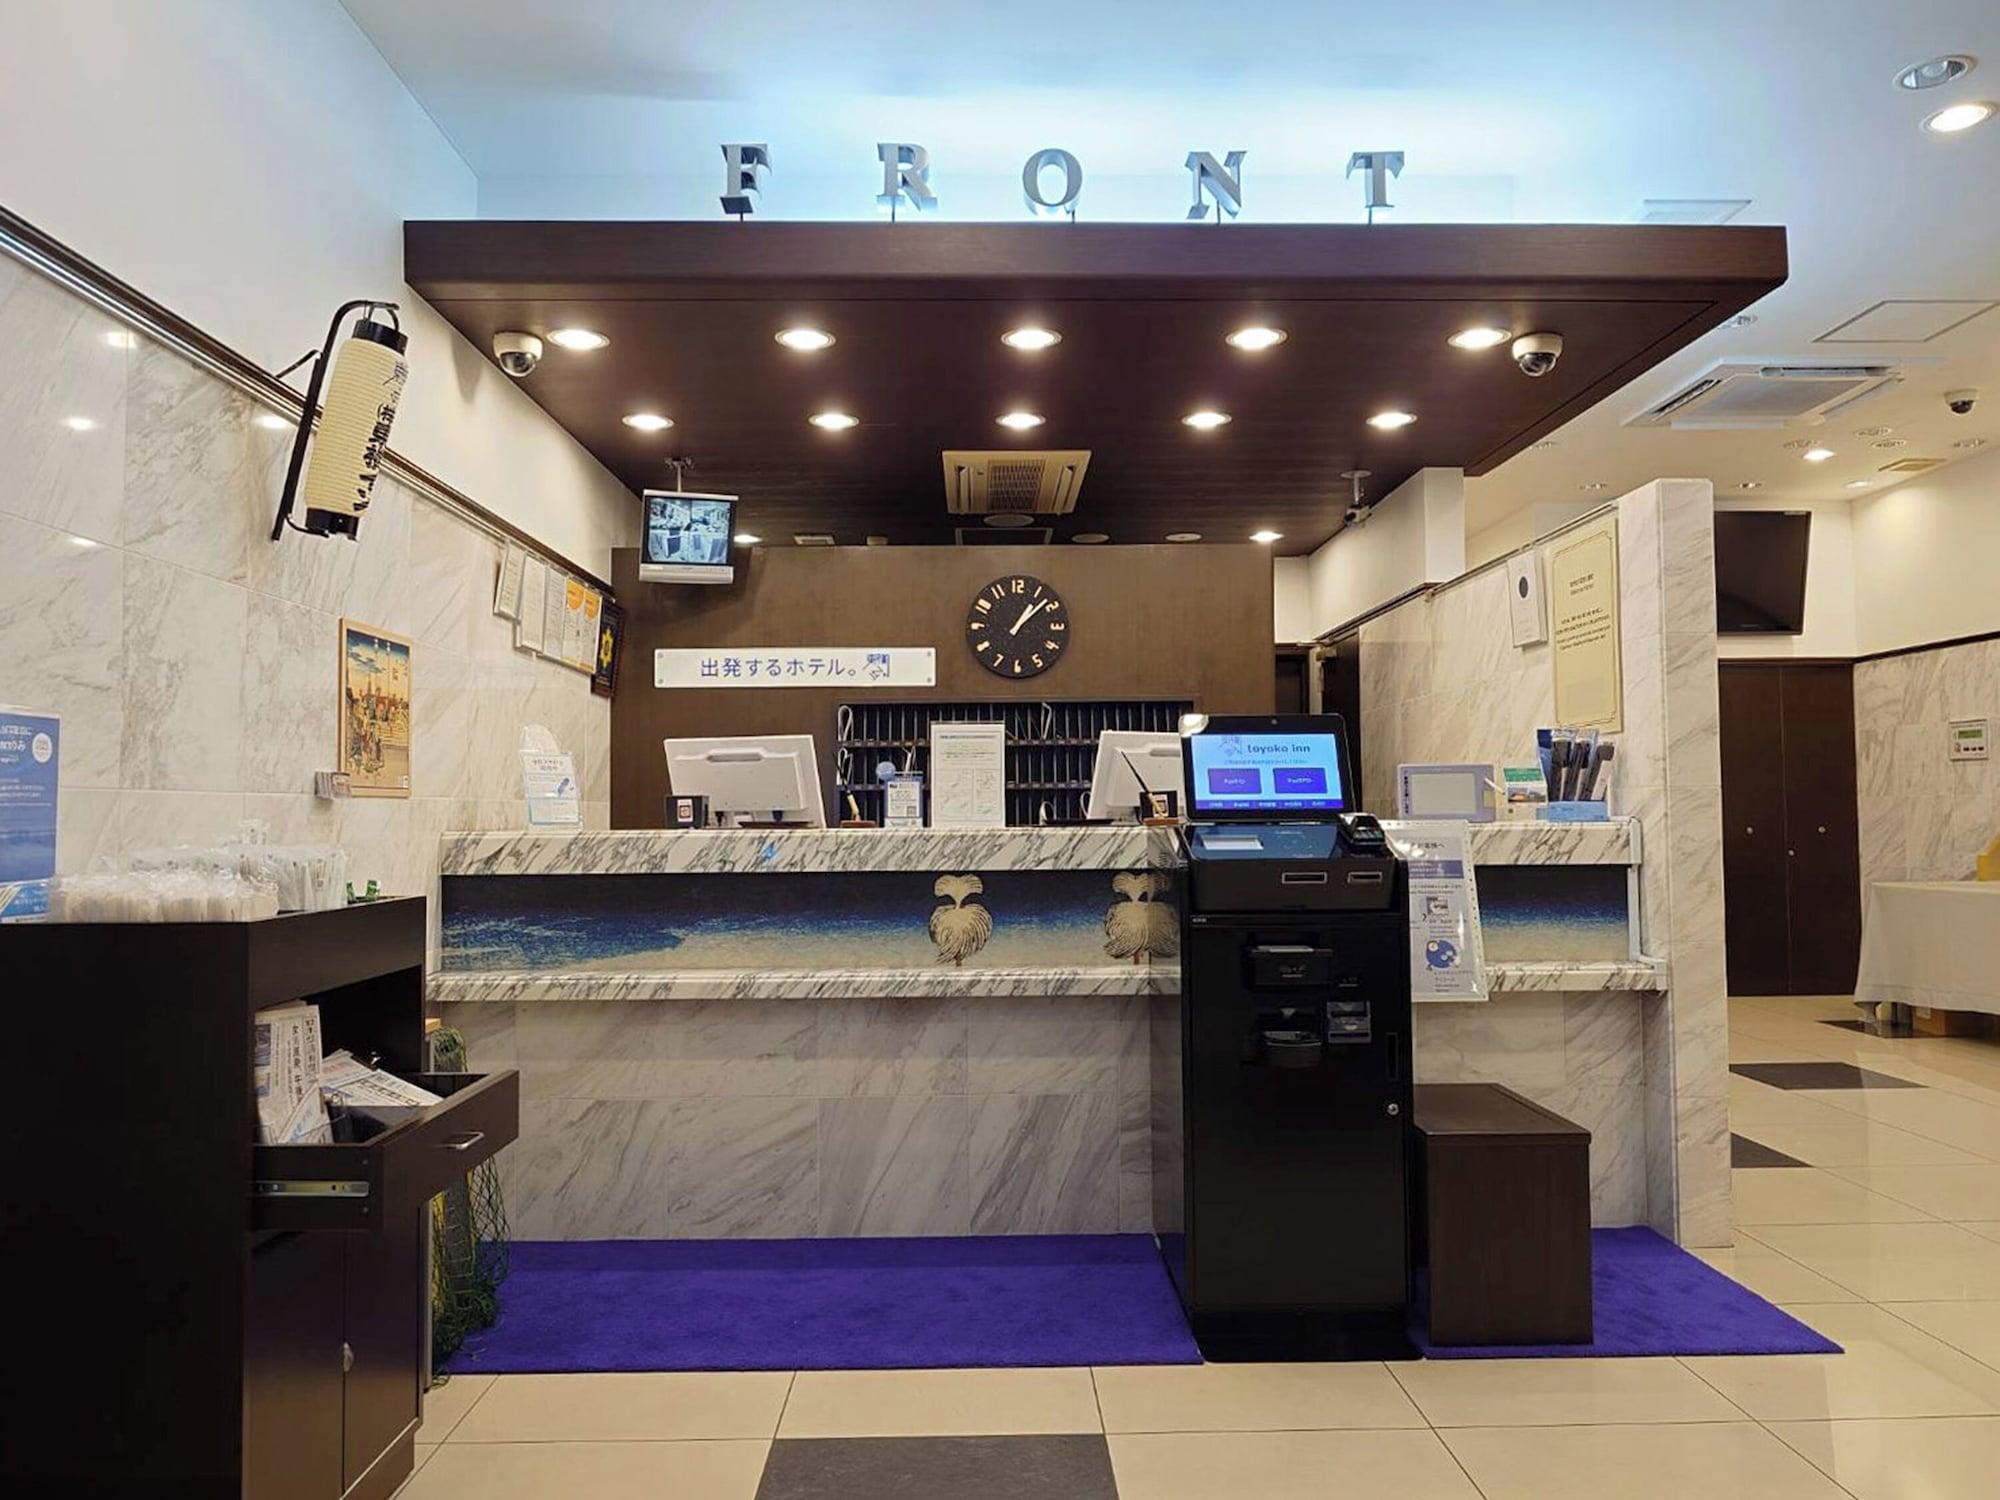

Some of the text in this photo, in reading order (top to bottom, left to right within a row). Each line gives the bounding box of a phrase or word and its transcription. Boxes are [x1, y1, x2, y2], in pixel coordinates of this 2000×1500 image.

[720, 143, 1404, 218] FRONT
[1011, 579, 1025, 594] 12
[1045, 600, 1060, 613] 2
[1049, 622, 1065, 631] 3
[1044, 639, 1060, 651] 4
[700, 658, 856, 678] 出発するホテル。
[992, 653, 1005, 668] 7
[1013, 659, 1022, 674] 6
[1031, 653, 1045, 669] 5
[1247, 743, 1289, 754] toyoko
[1291, 743, 1311, 753] inn
